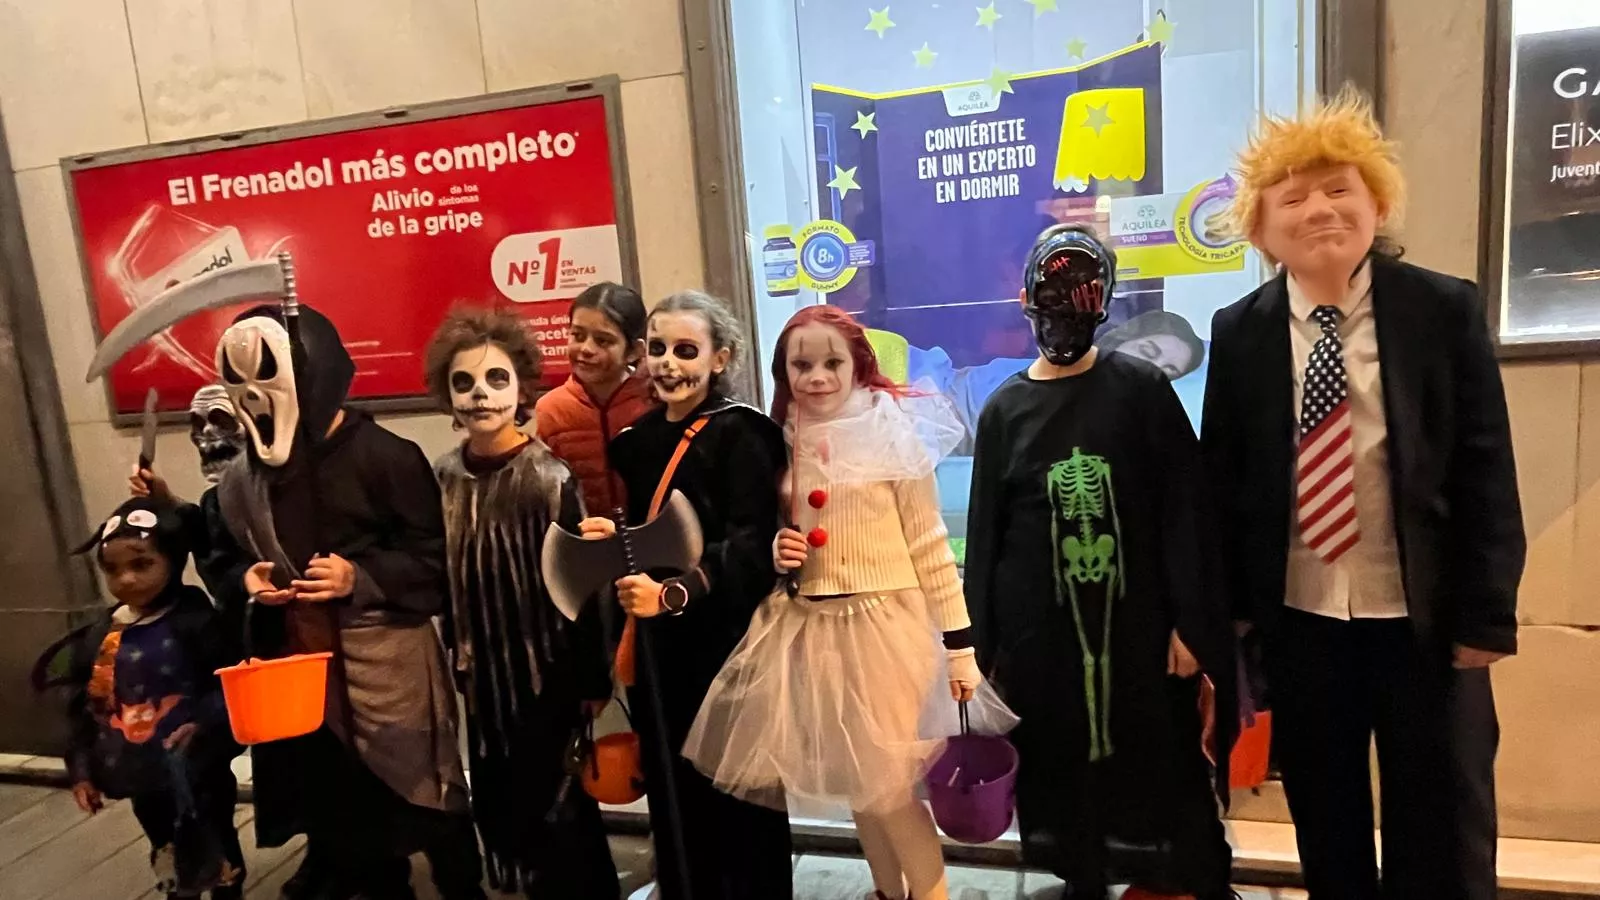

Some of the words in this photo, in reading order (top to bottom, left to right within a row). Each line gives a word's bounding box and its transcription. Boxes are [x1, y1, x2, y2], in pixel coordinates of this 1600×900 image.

[958, 102, 989, 111] AQUILEA
[925, 118, 1026, 152] CONVIÉRTETE
[918, 156, 937, 180] EN
[942, 153, 964, 177] UN
[969, 144, 1036, 174] EXPERTO
[168, 176, 197, 206] El
[202, 157, 333, 201] Frenadol
[341, 149, 407, 184] más
[450, 185, 462, 195] de
[464, 183, 478, 193] los
[936, 181, 955, 203] EN
[960, 174, 1020, 201] DORMIR
[371, 188, 434, 212] Alivio
[368, 217, 395, 238] de
[399, 215, 420, 235] la
[424, 209, 484, 235] gripe
[802, 226, 840, 238] FORMATO
[1122, 219, 1168, 231] AQUILEA
[817, 248, 834, 263] 8h
[561, 266, 596, 276] VENTAS
